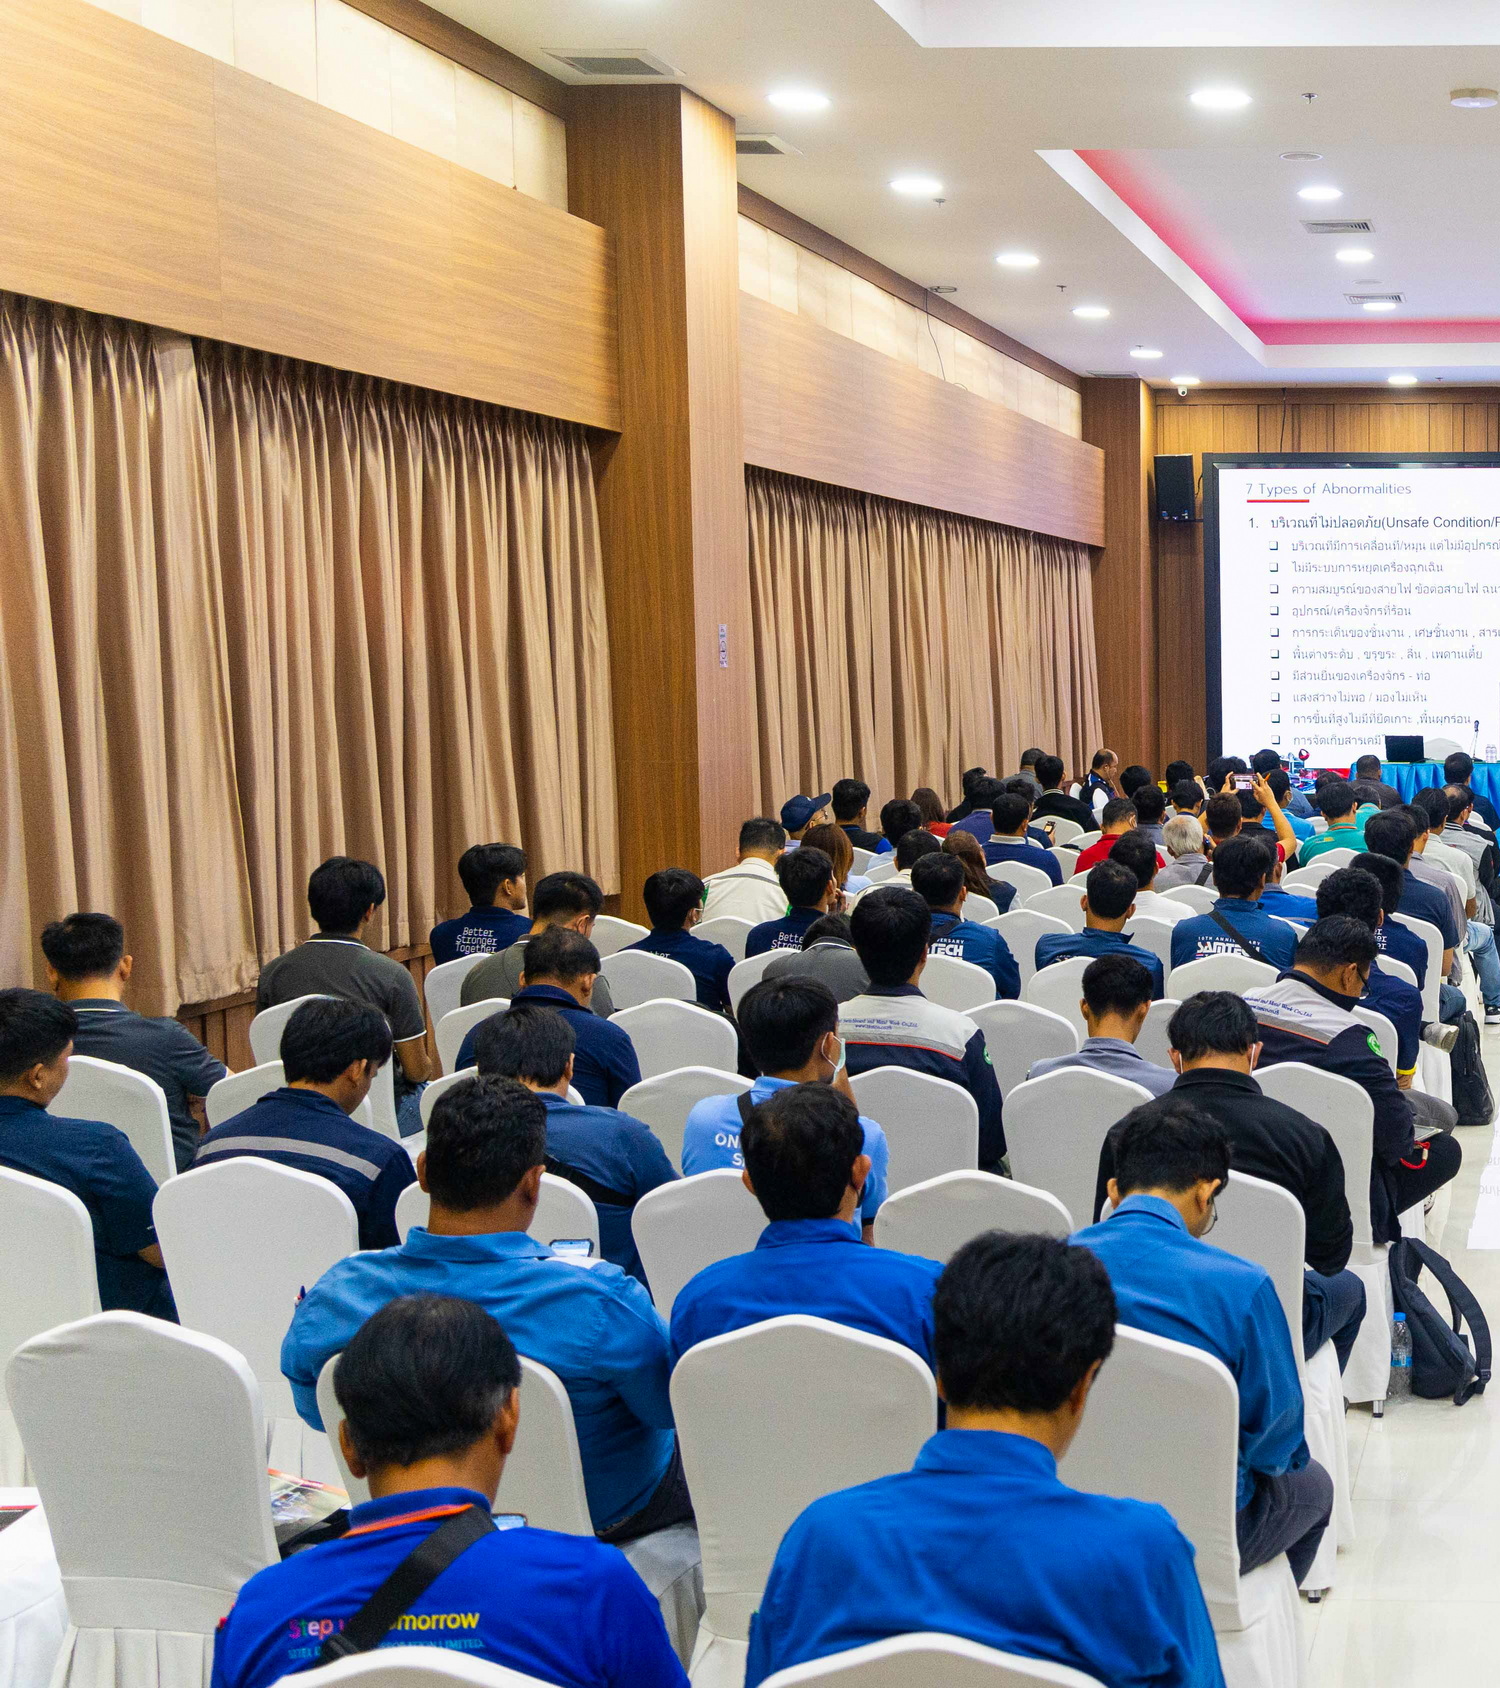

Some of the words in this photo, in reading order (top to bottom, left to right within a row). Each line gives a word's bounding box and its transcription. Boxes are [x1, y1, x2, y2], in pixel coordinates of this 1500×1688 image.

[1245, 483, 1253, 495] 7
[1258, 483, 1298, 498] Types
[1303, 482, 1316, 495] of
[1322, 482, 1412, 495] Abnormalities
[1248, 517, 1259, 529] 1.
[1293, 734, 1385, 746] การจัดเก็บสารเคมี
[463, 926, 495, 937] Better
[778, 931, 804, 943] Bette
[456, 934, 498, 946] Stronger
[1215, 936, 1261, 945] ANNIARY
[455, 941, 498, 955] Together
[926, 942, 964, 957] TECH
[289, 1618, 334, 1640] Step
[390, 1612, 480, 1631] morrow
